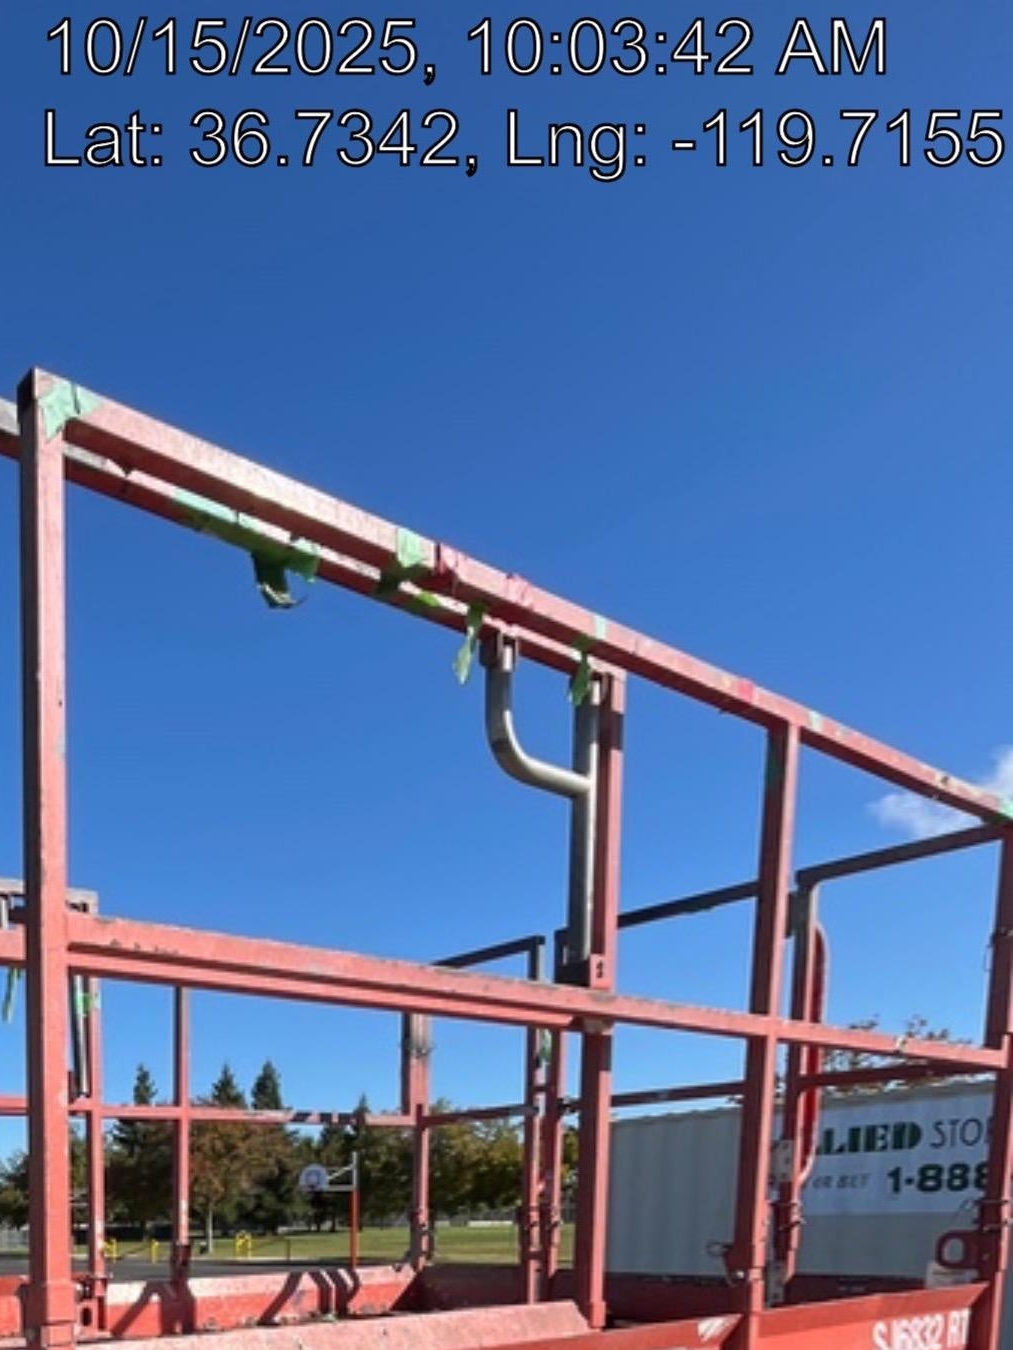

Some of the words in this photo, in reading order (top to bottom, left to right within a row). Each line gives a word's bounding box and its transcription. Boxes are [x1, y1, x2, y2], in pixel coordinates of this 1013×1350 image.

[816, 1121, 922, 1156] LIED
[930, 1116, 994, 1150] STO
[947, 1306, 971, 1349] RT
